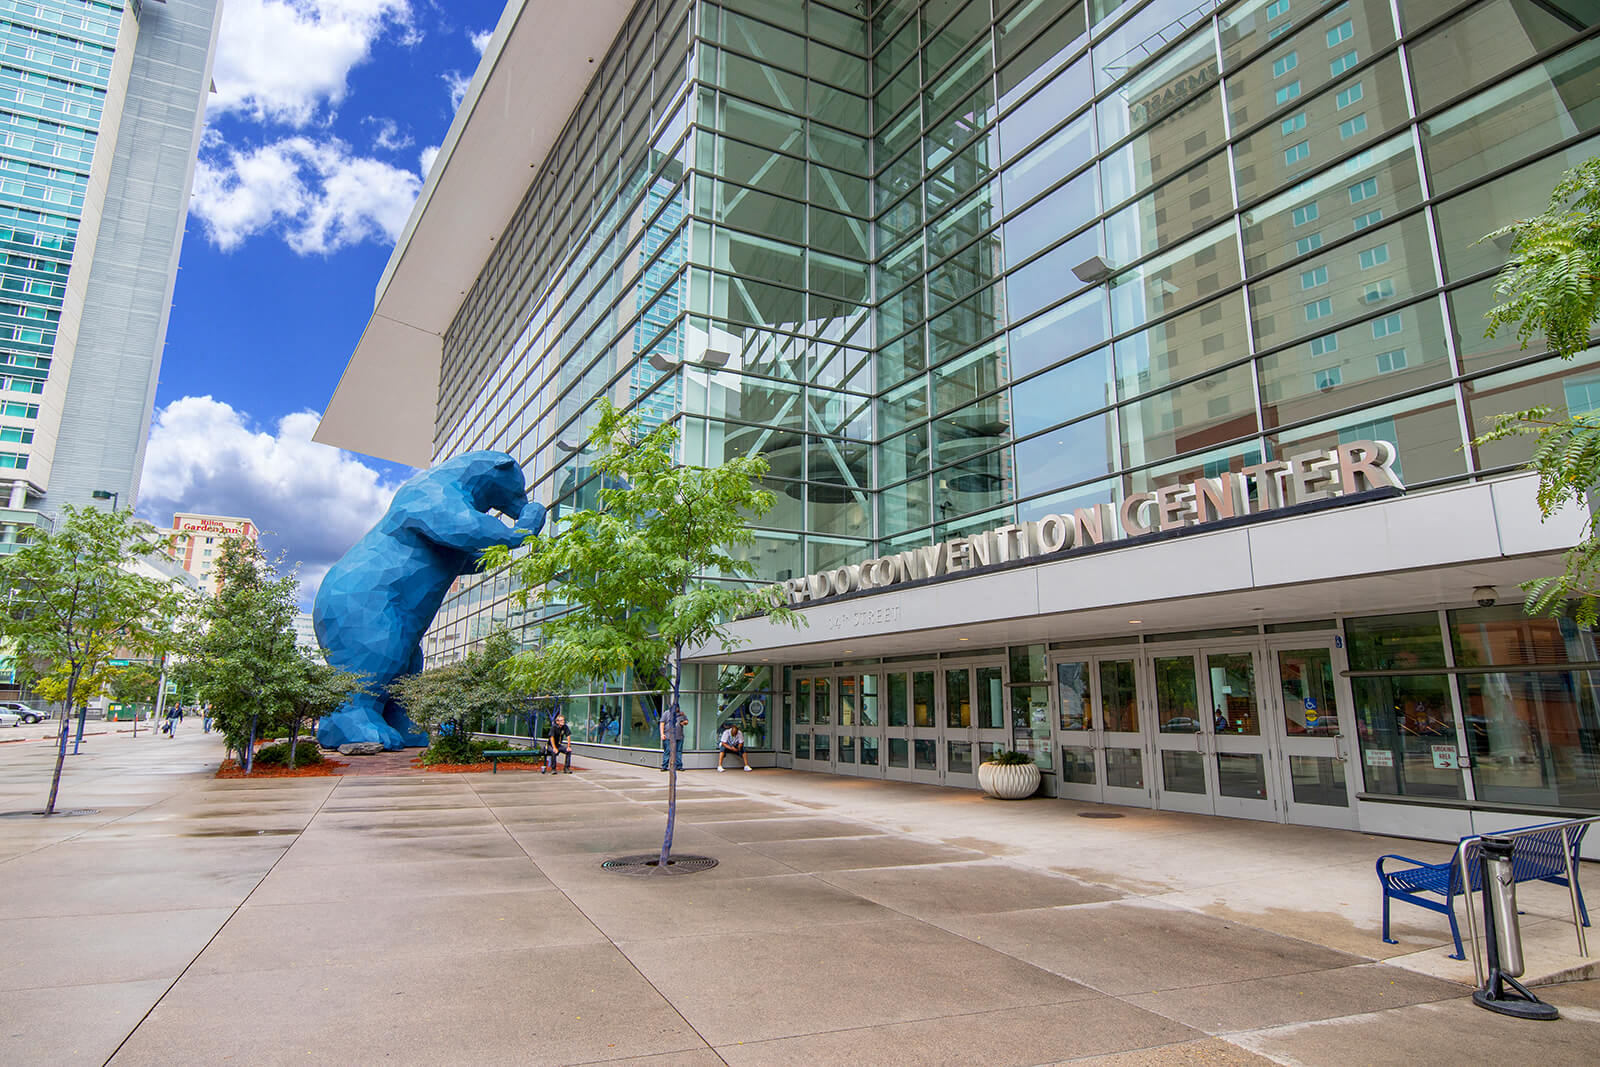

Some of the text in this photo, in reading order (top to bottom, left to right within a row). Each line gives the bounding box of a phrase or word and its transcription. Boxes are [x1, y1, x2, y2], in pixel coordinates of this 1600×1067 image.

[859, 503, 1107, 588] CONVENTION
[1120, 440, 1393, 535] CENTER
[183, 523, 219, 532] Garden
[854, 606, 899, 627] STREET
